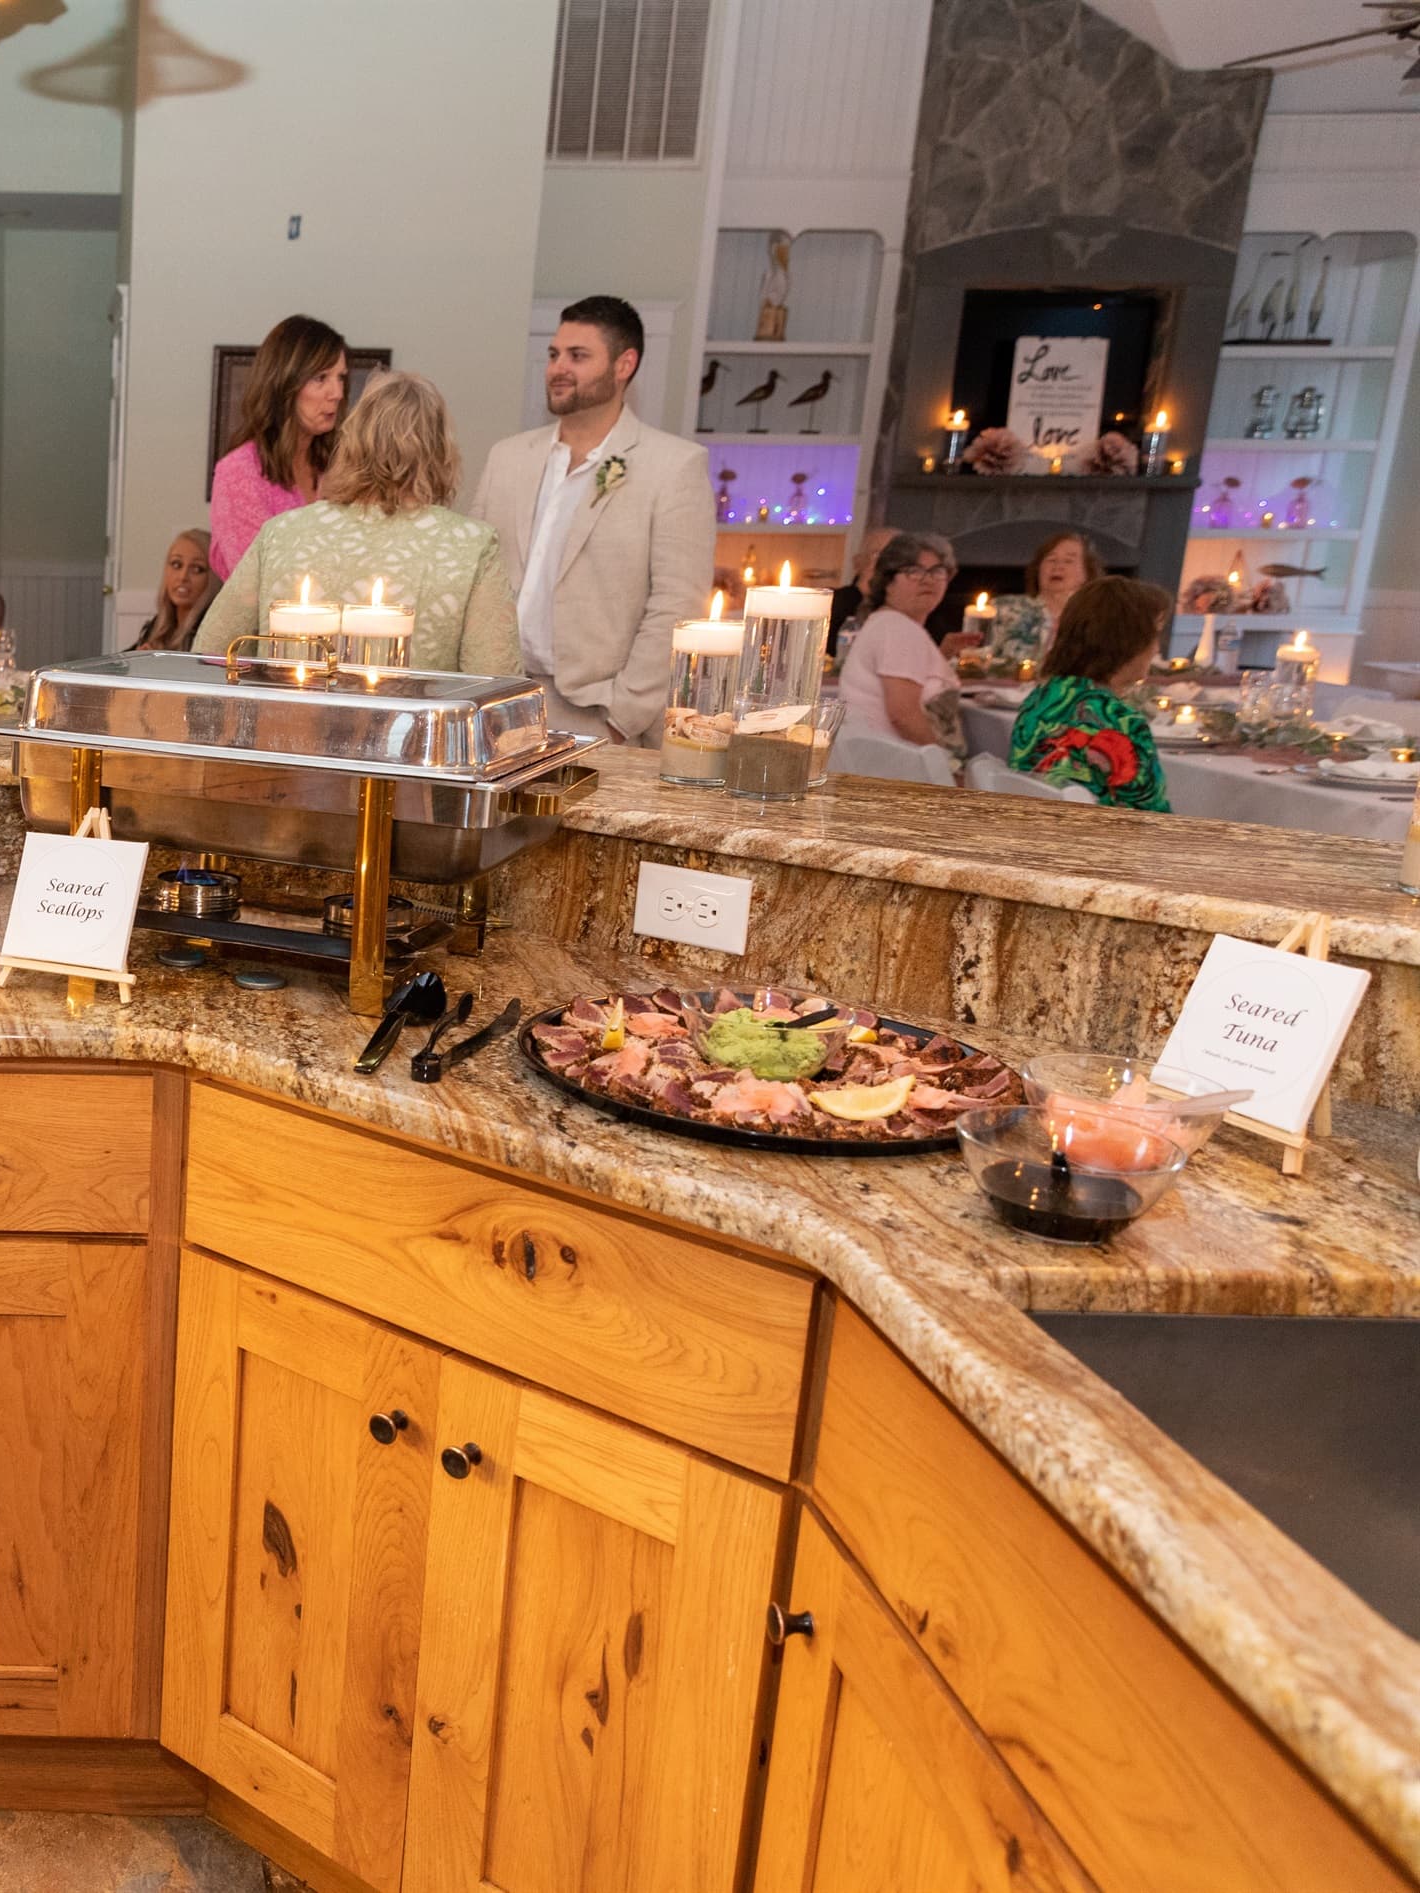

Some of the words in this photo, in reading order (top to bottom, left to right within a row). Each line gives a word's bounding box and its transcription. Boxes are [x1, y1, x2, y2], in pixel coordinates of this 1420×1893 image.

[1017, 344, 1082, 384] Love
[1028, 416, 1081, 446] love
[46, 878, 109, 898] Seared
[36, 900, 105, 923] Scallops
[1224, 993, 1308, 1028] Seared
[1222, 1023, 1279, 1053] Tuna
